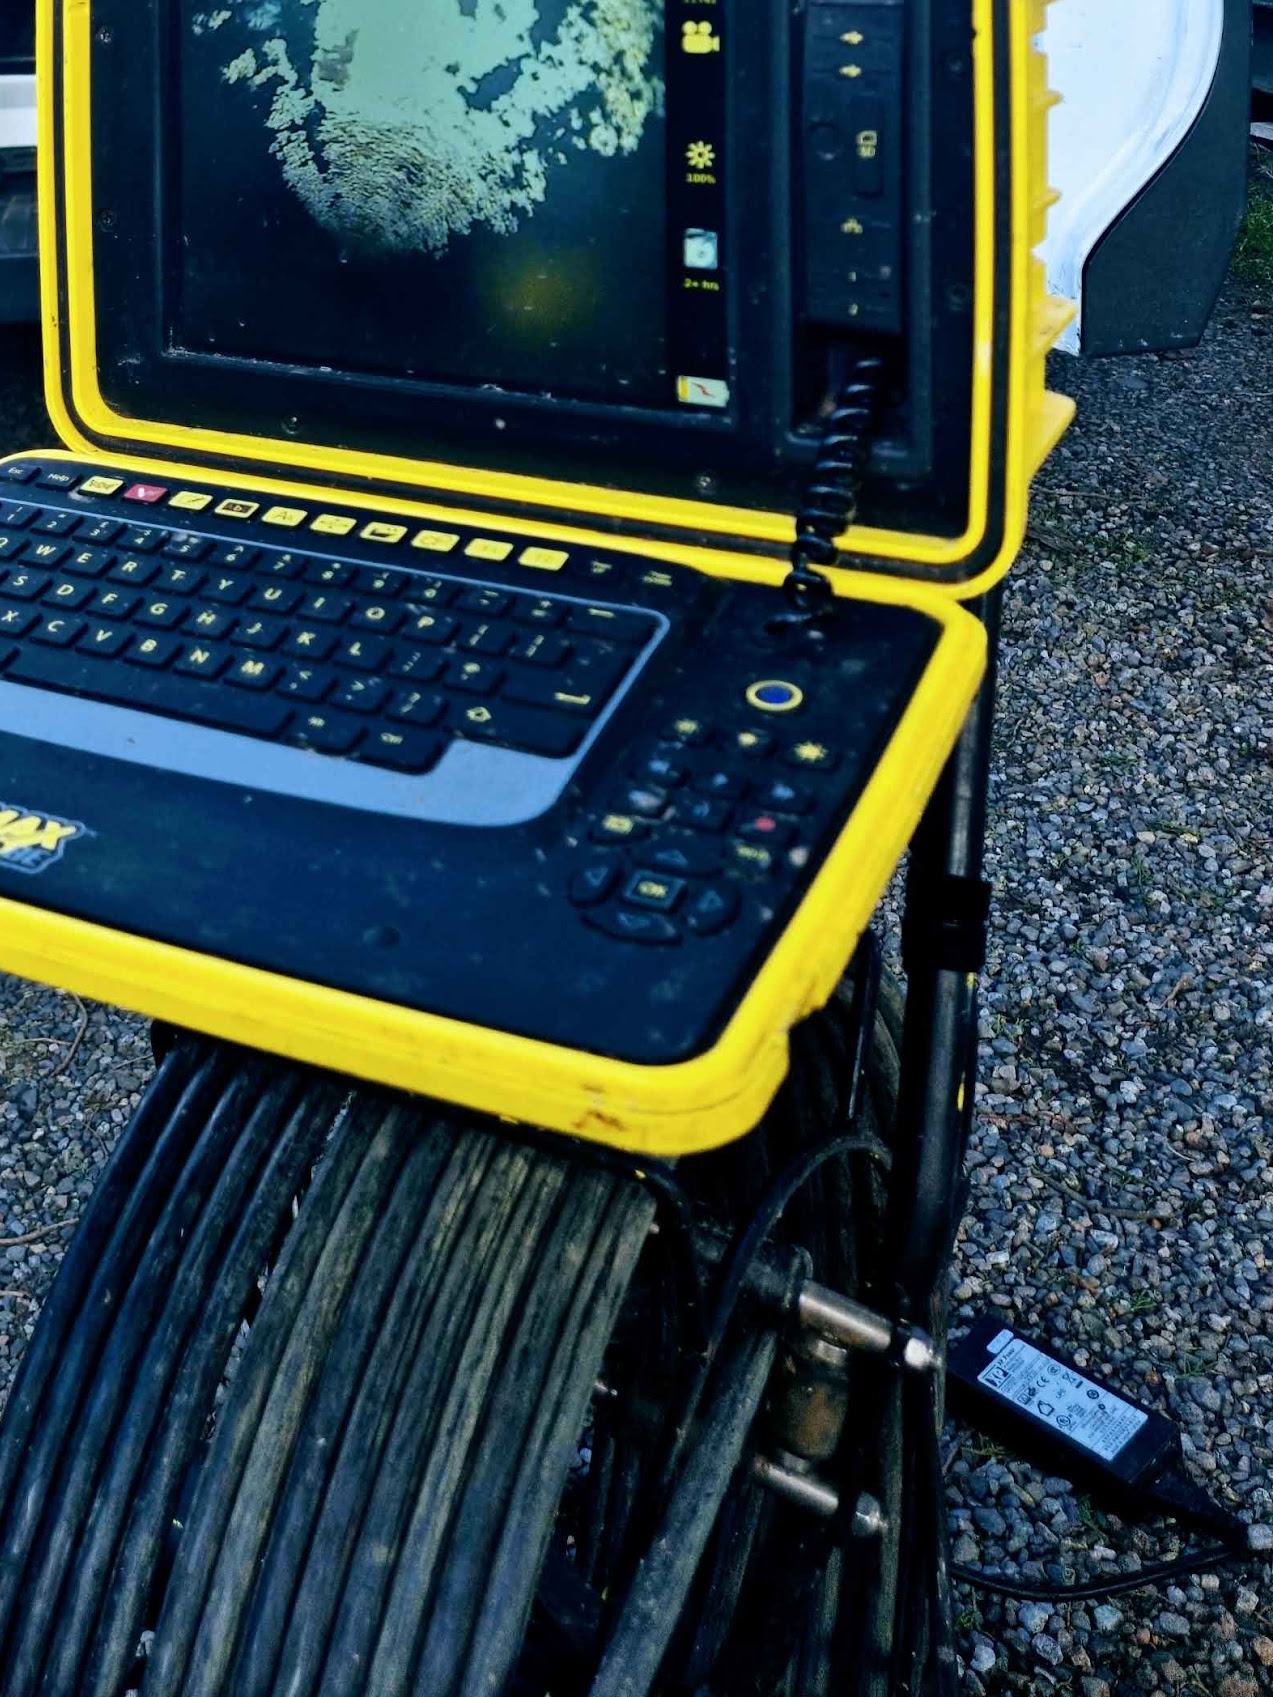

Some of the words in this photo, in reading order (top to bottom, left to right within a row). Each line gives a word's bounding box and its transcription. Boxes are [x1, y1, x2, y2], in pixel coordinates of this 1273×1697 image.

[8, 467, 24, 475] Esc
[47, 472, 70, 482] Help
[13, 575, 28, 587] S
[56, 584, 75, 596] D
[101, 593, 118, 604] F
[149, 602, 168, 615] G
[0, 610, 19, 622] X
[196, 611, 217, 625] H
[47, 620, 65, 632] C
[246, 622, 263, 635] J
[96, 629, 113, 642] V
[296, 631, 317, 646] K
[139, 639, 158, 653] B
[348, 641, 362, 656] L
[189, 648, 210, 664] N
[240, 660, 265, 675] M
